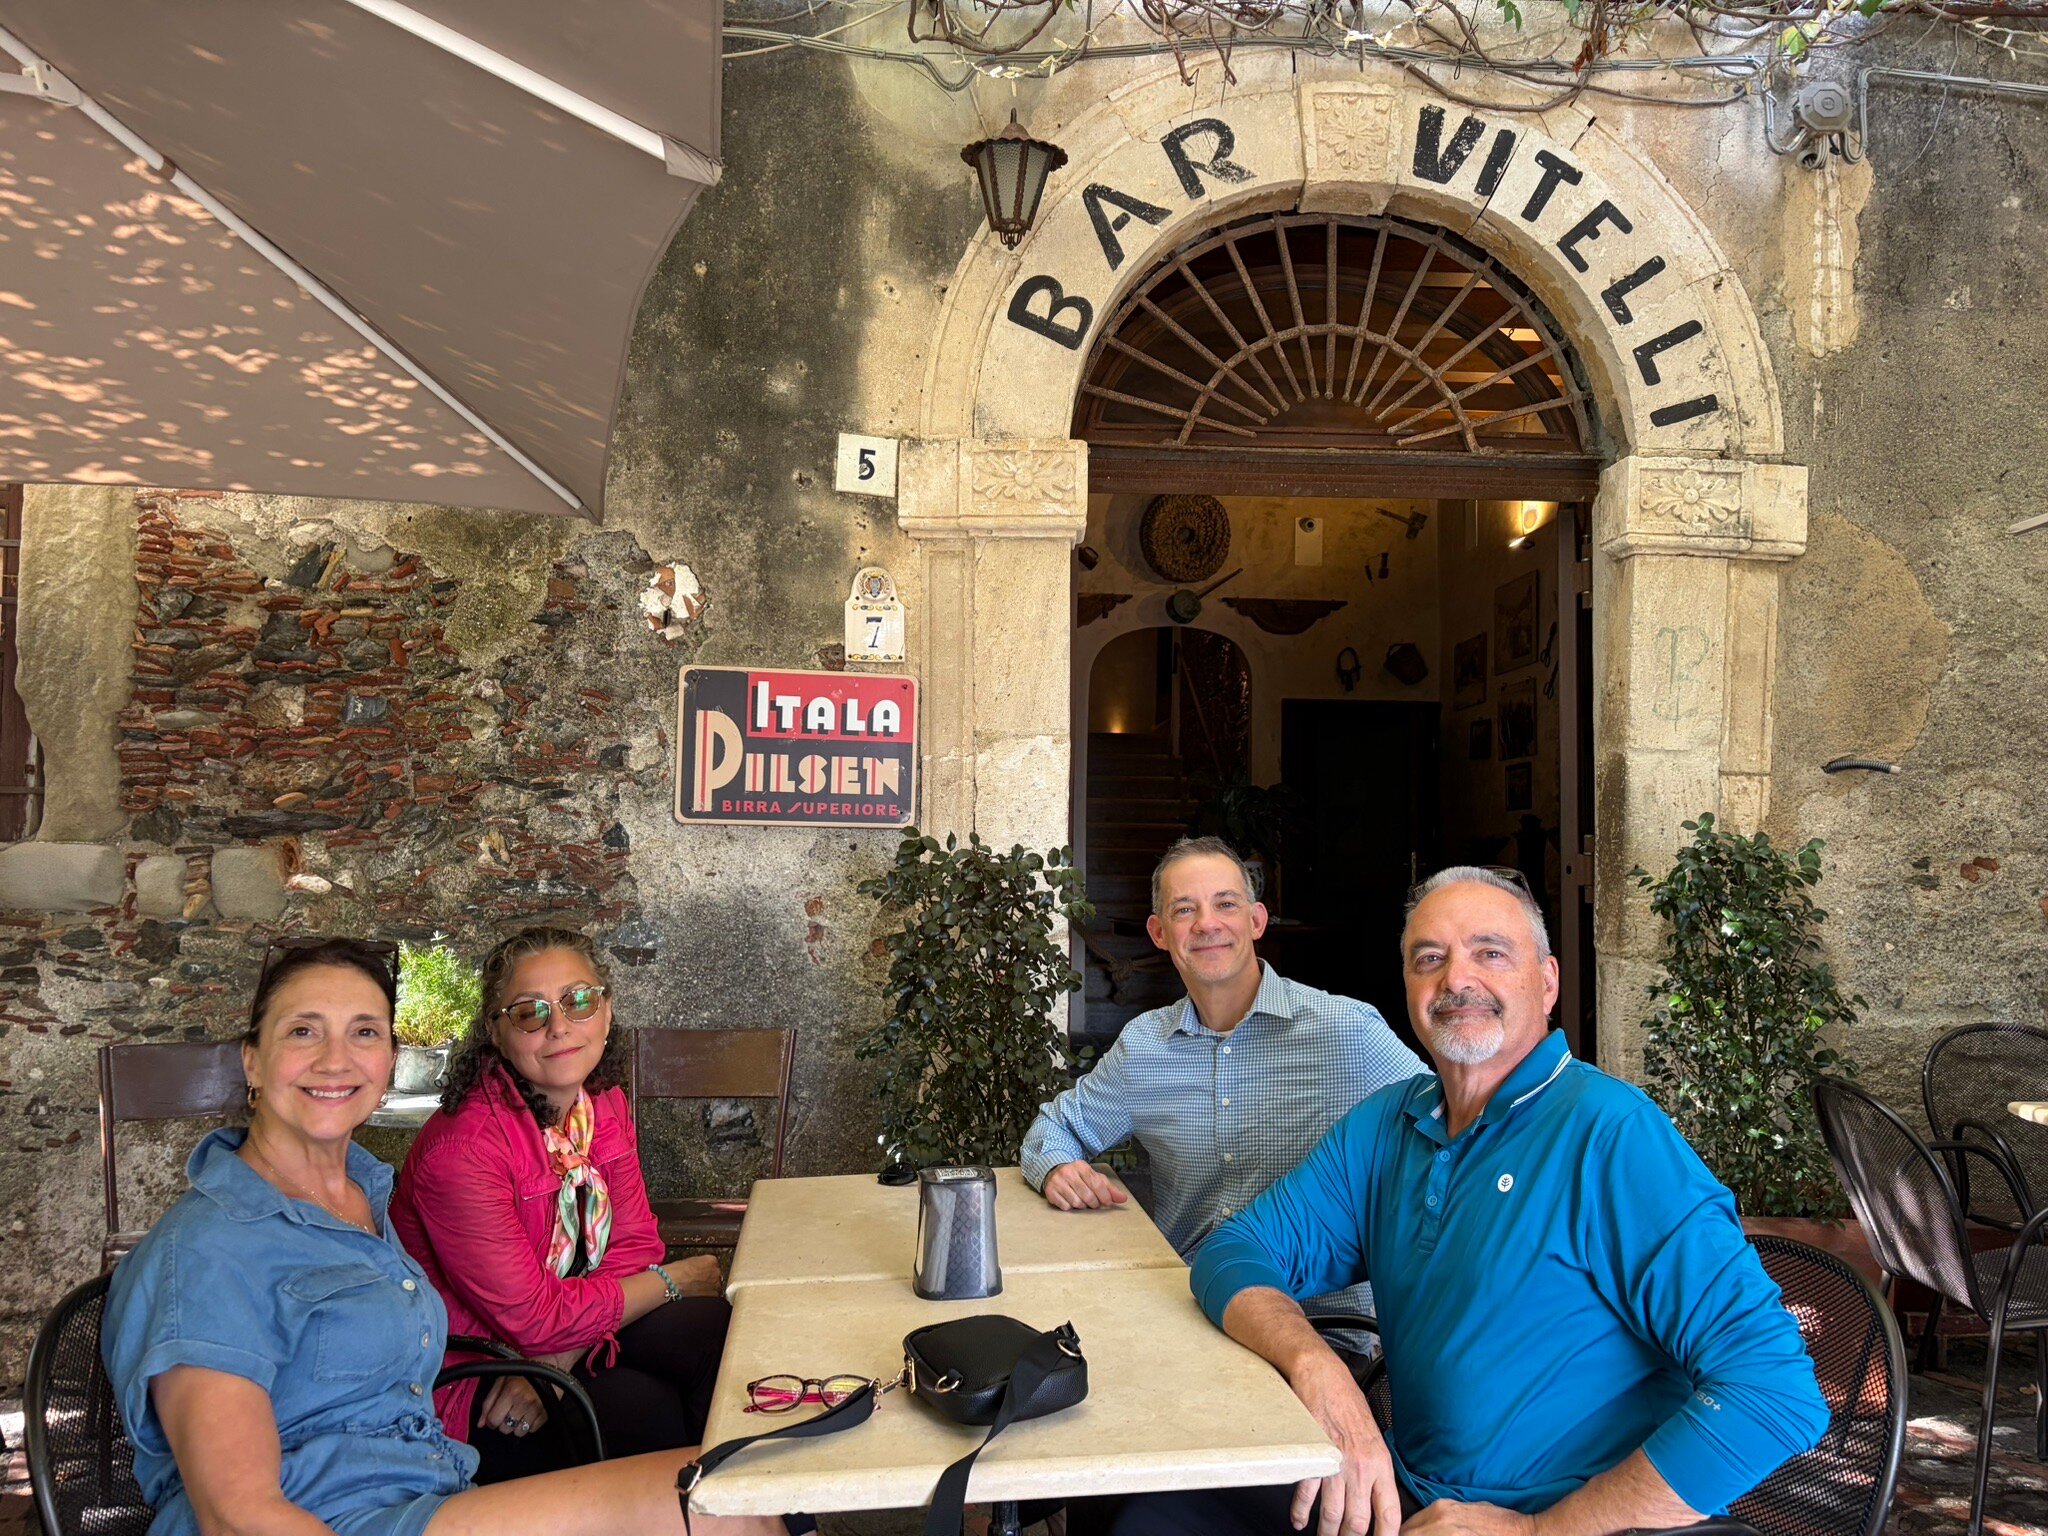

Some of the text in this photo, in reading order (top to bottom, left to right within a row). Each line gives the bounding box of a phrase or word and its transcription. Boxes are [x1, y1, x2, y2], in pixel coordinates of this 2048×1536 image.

[1007, 103, 1718, 427] BAR VITELLI
[857, 448, 876, 481] 5
[865, 616, 883, 650] 7
[755, 680, 901, 733] ITALA
[693, 709, 900, 813] PILSEN
[721, 799, 899, 817] BIRRA SUPERIORE
